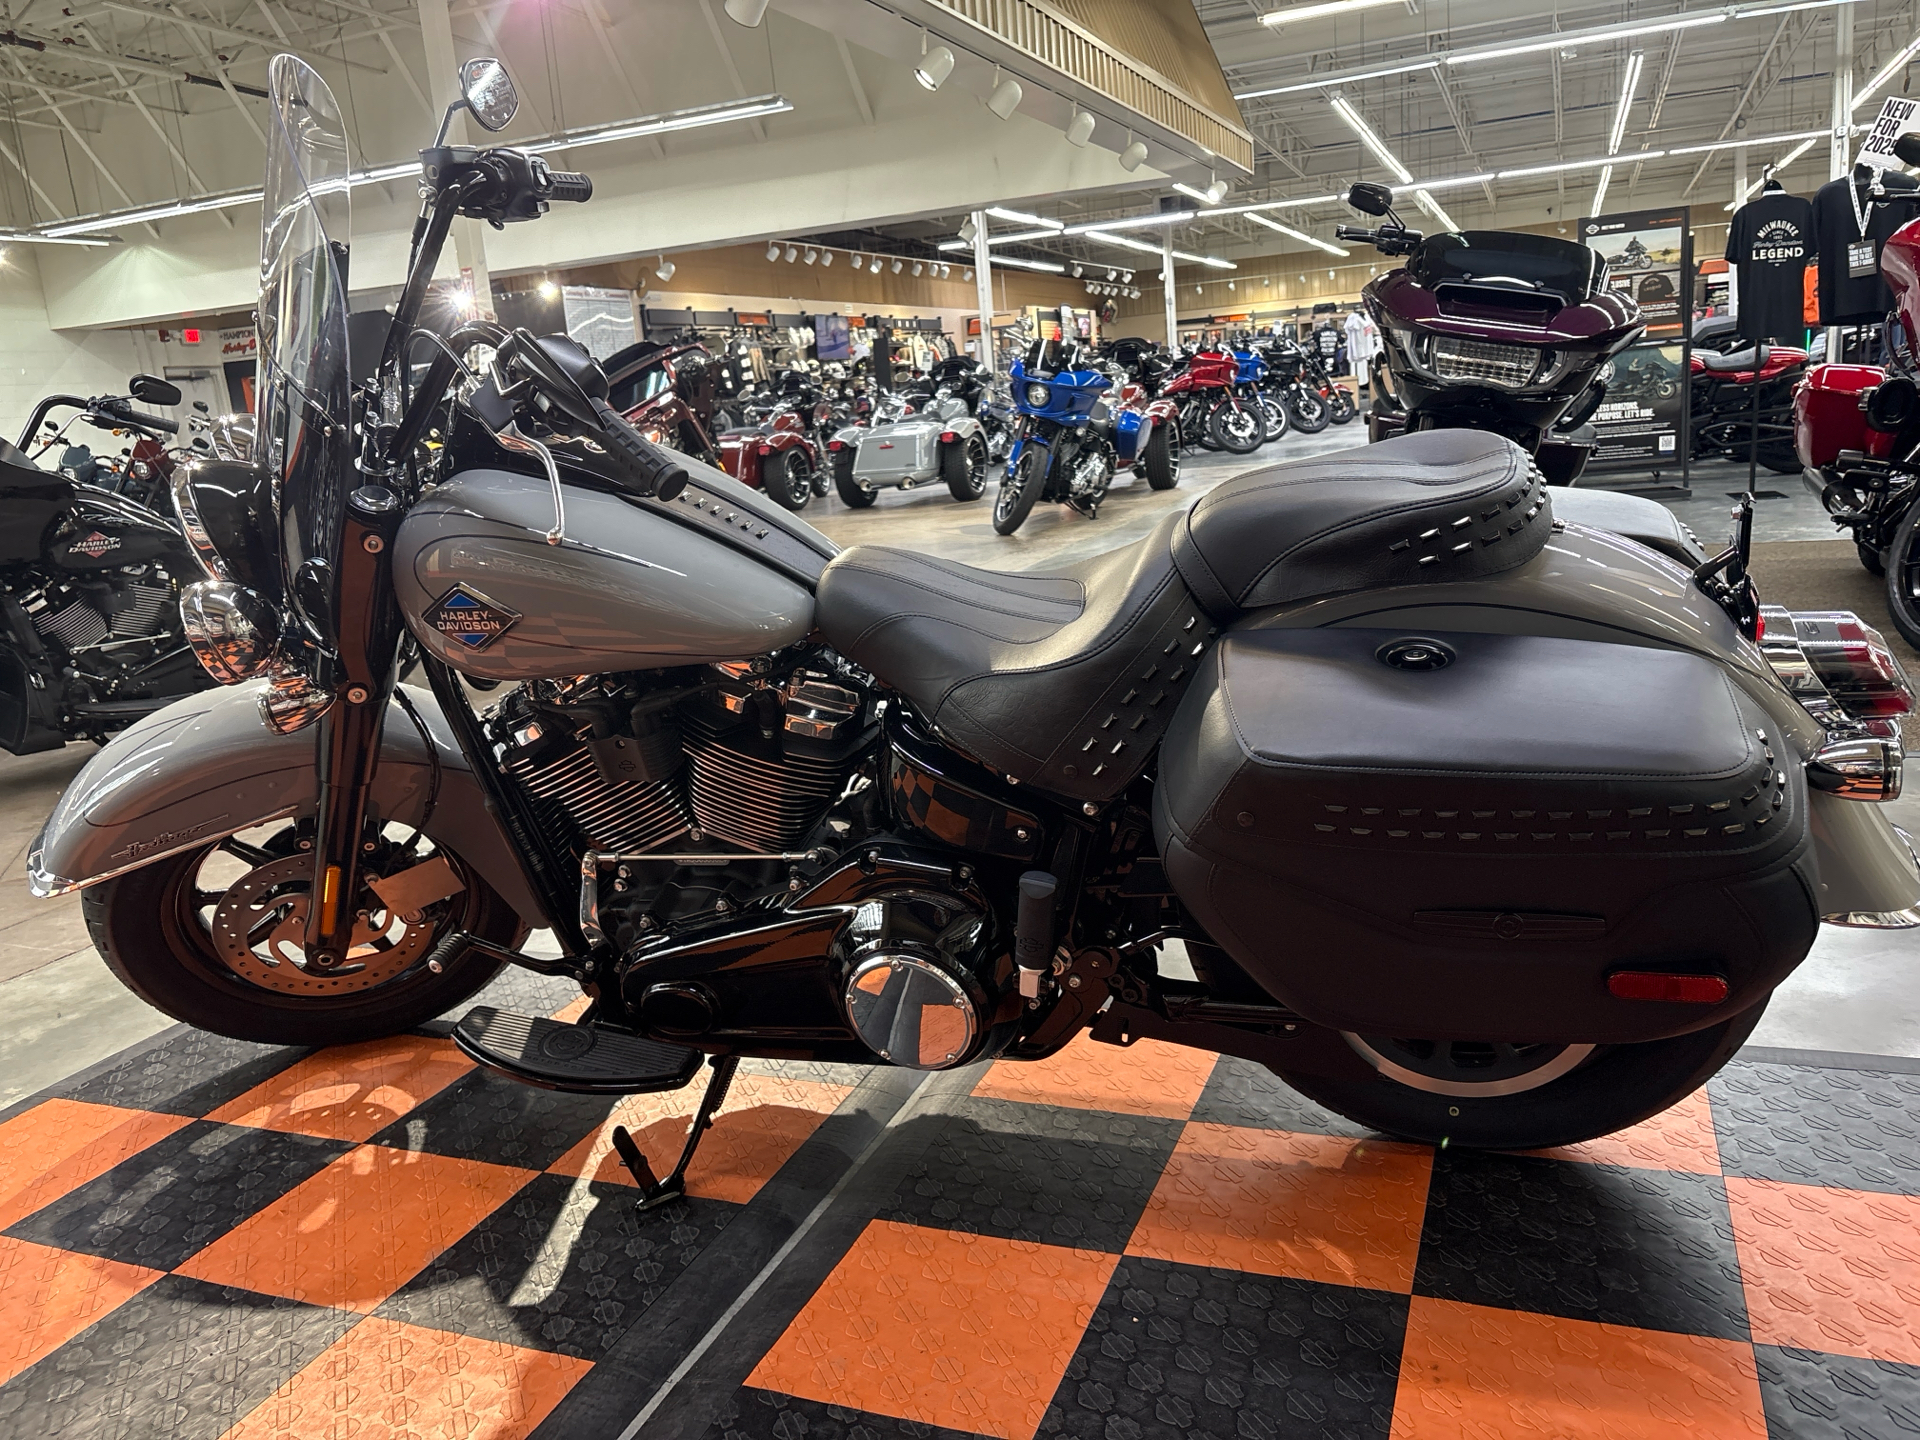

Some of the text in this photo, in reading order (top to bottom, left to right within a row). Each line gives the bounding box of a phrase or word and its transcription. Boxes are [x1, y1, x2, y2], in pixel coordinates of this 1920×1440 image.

[1882, 100, 1916, 120] NEW
[1873, 117, 1901, 138] FOR
[1864, 135, 1898, 157] 2025
[1757, 220, 1800, 239] MILWAUKEE
[1752, 247, 1804, 260] LEGEND
[68, 542, 121, 553] DAVIDSON
[440, 610, 493, 621] HARLEY-
[436, 620, 501, 631] DAVIDSON
